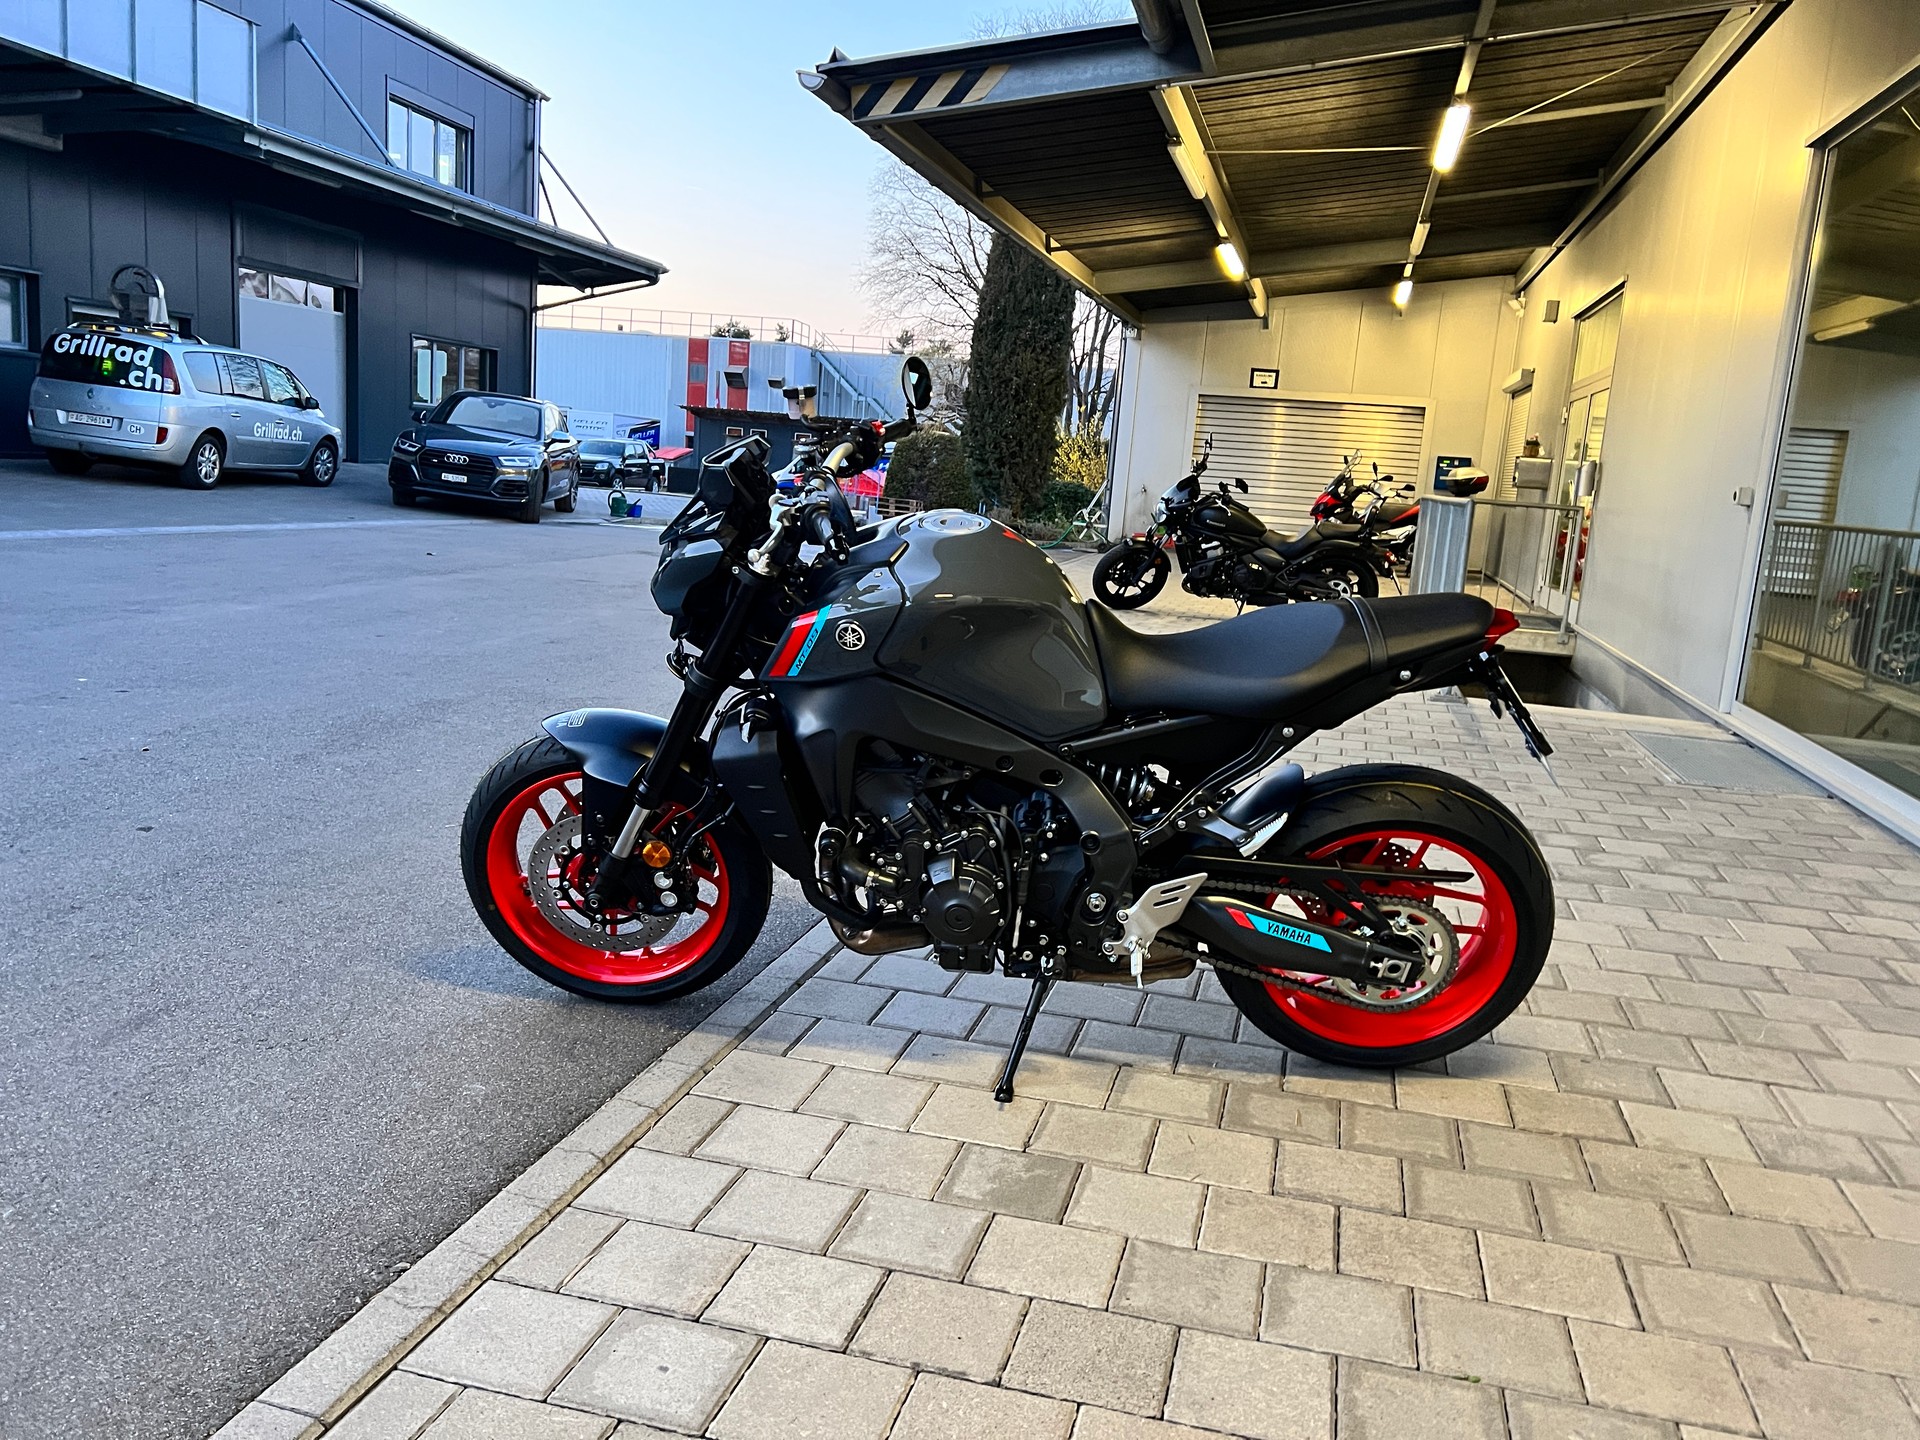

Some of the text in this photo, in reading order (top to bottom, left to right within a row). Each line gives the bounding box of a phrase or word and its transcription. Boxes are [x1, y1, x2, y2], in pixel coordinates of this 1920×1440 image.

[54, 333, 154, 368] Grillrad
[119, 366, 162, 391] .ch
[129, 424, 141, 434] CH
[253, 421, 302, 441] Grillrad.ch
[1267, 921, 1311, 945] YAMAHA
